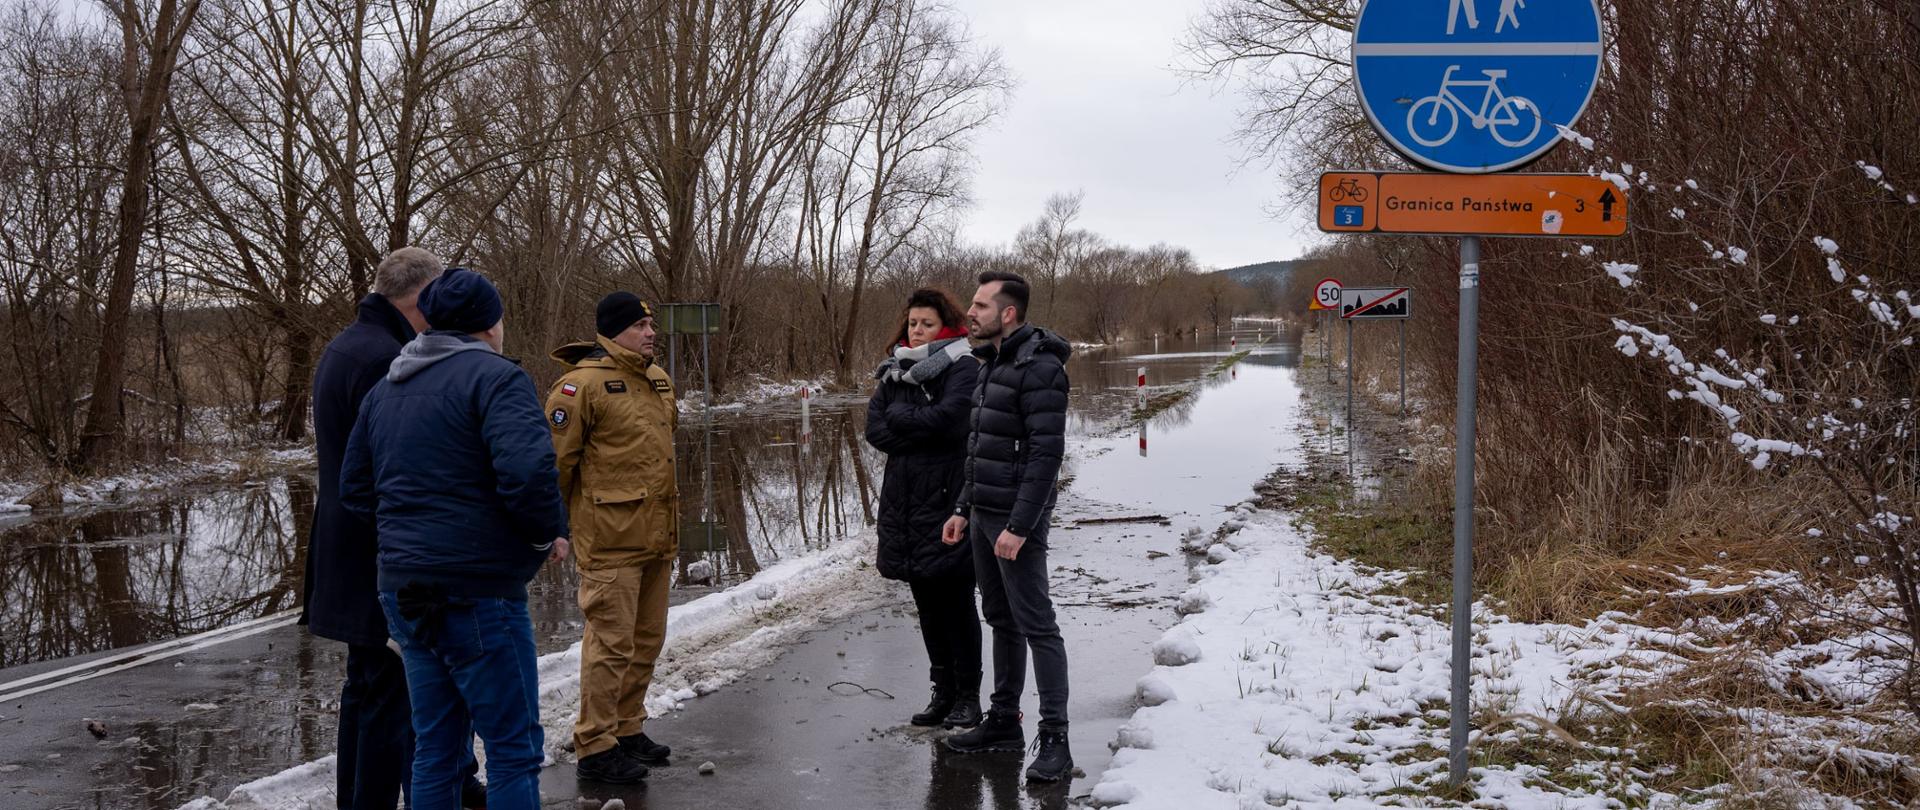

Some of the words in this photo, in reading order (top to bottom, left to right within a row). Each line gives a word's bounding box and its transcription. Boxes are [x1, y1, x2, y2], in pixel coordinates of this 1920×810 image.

[1385, 196, 1454, 211] Granica
[1462, 197, 1533, 213] Państwa
[1575, 199, 1585, 213] 3
[1344, 214, 1353, 224] 3
[1321, 287, 1339, 302] 50
